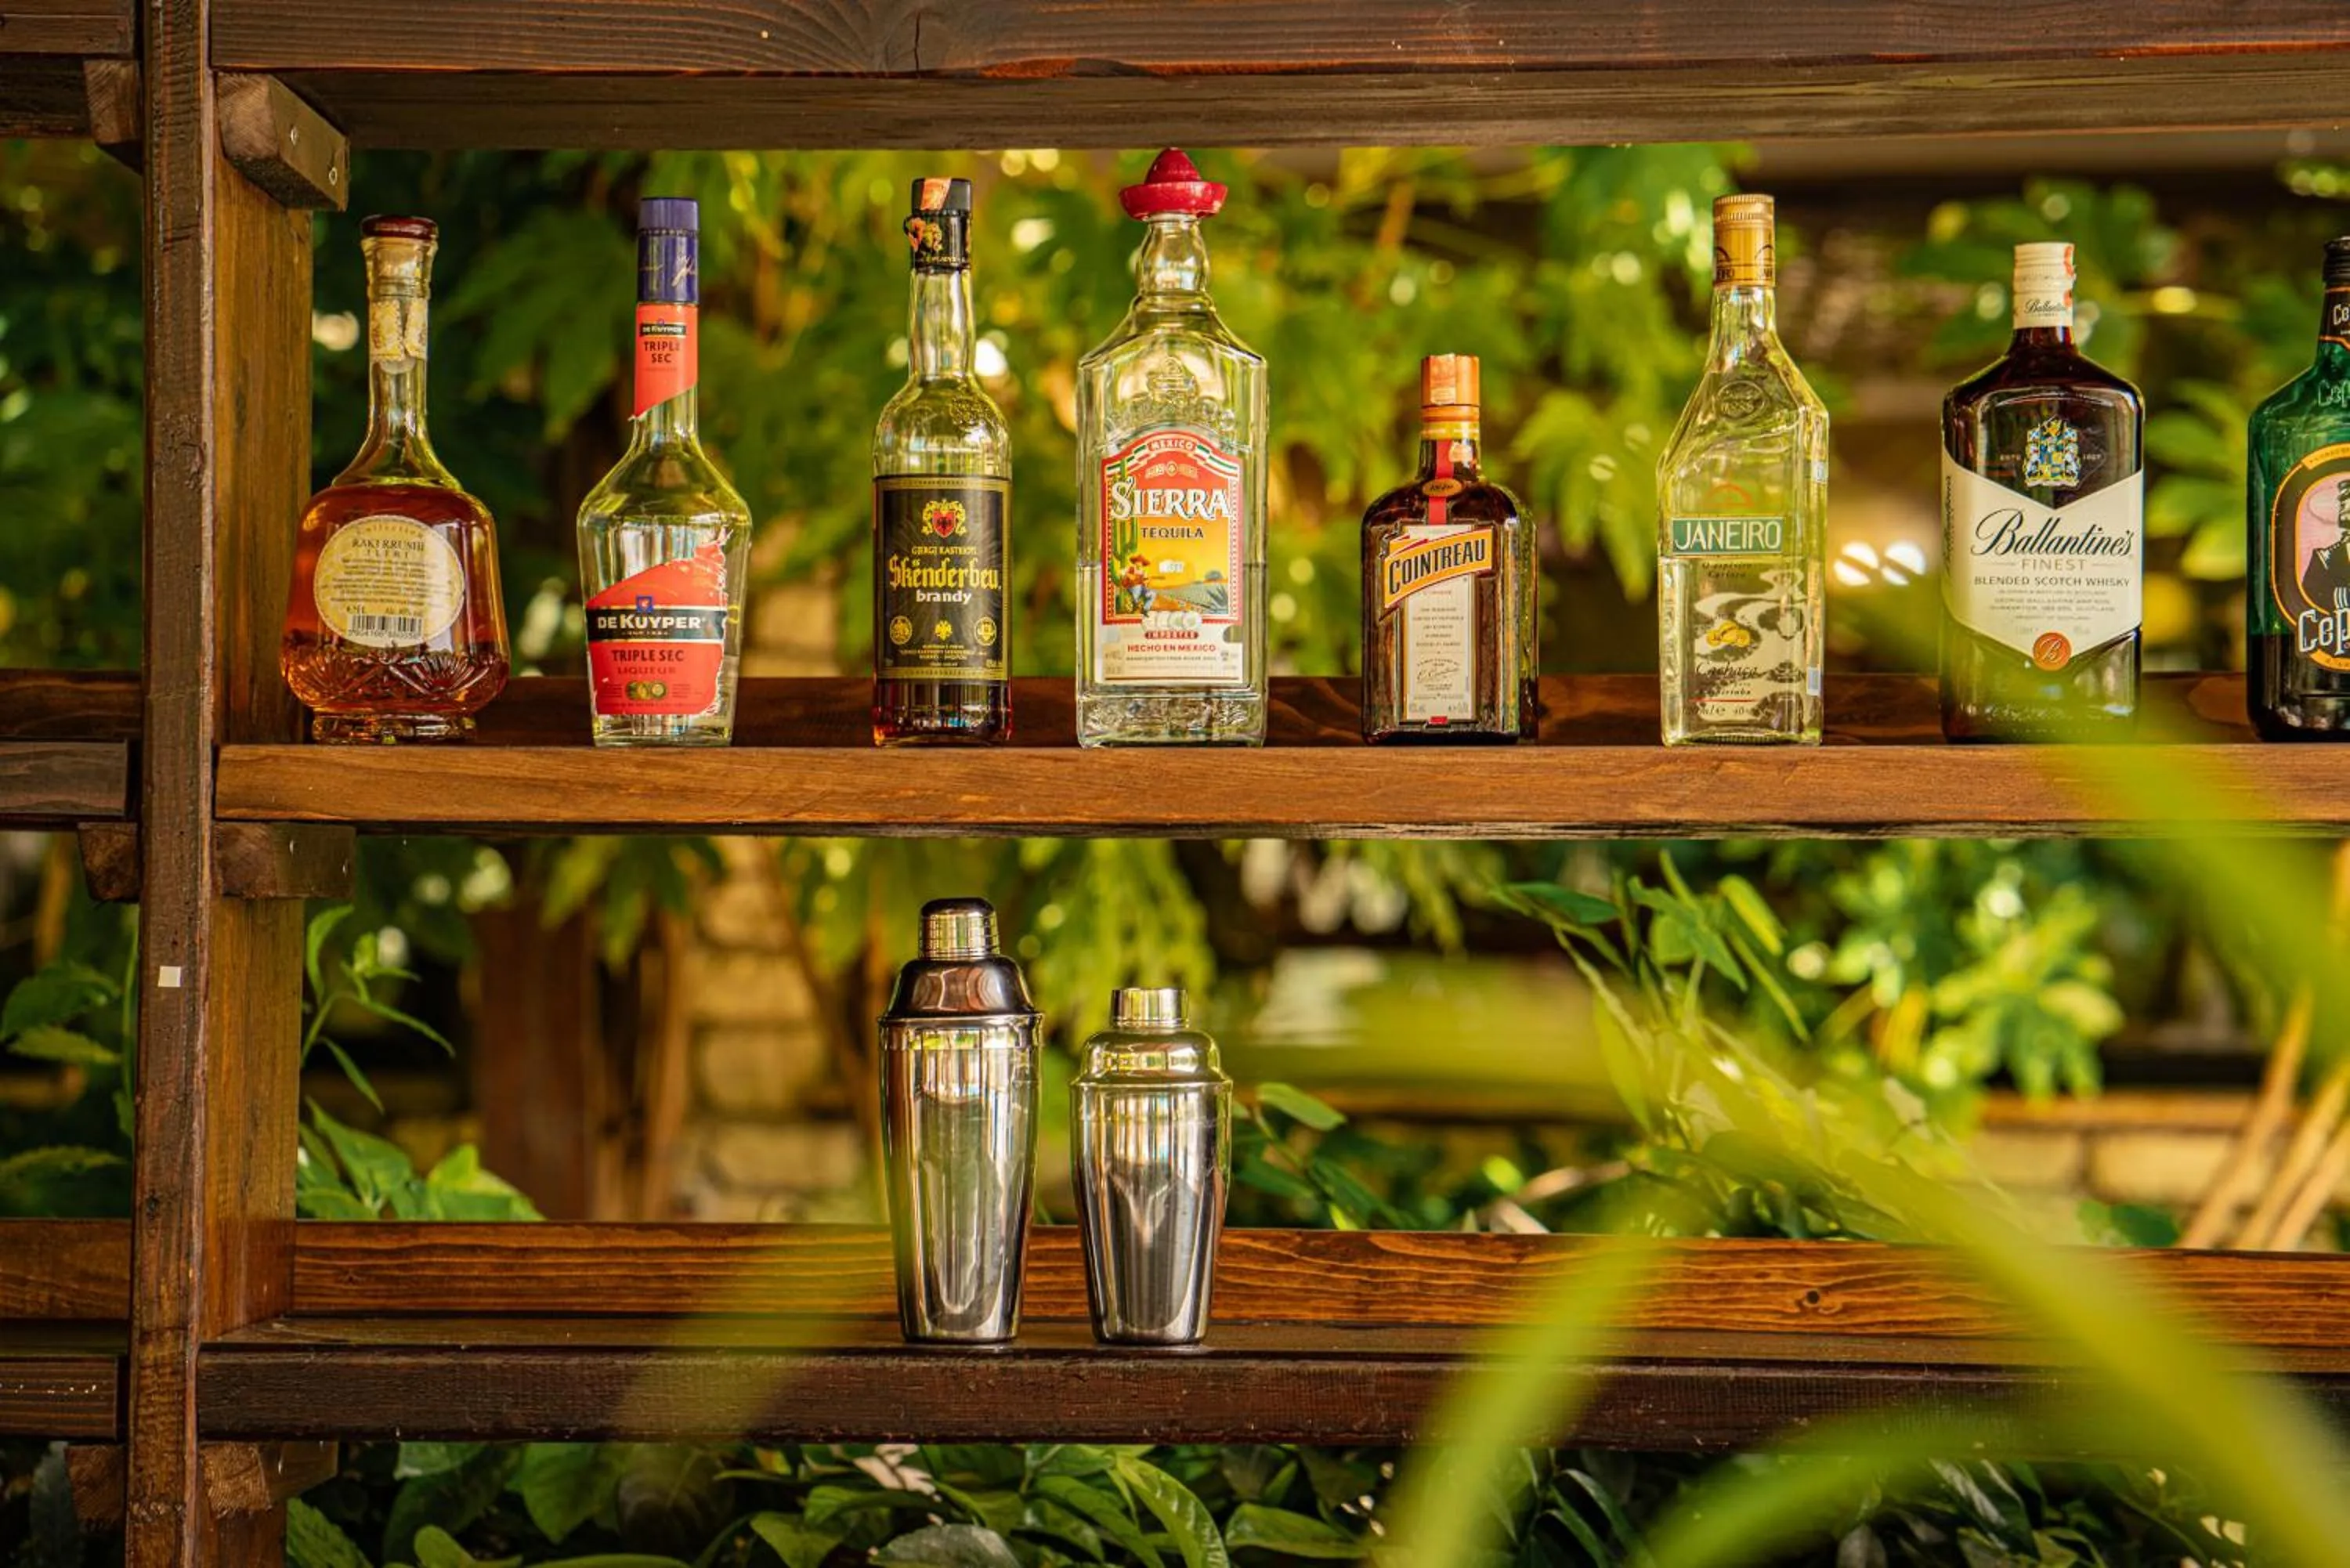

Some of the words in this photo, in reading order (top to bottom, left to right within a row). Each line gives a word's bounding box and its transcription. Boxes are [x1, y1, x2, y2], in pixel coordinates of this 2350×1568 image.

[644, 341, 680, 352] TRIPLE
[651, 353, 671, 363] SEC
[1111, 475, 1231, 520] SIERRA
[1141, 527, 1204, 538] TEQUILA
[1675, 520, 1781, 550] JANEIRO
[1970, 508, 2135, 557] Ballantine's
[1388, 537, 1487, 596] COINTREAU
[2021, 558, 2087, 571] FINEST
[1973, 576, 2030, 586] BLENDED
[2034, 576, 2082, 586] SCOTCH
[2085, 576, 2131, 587] WHISKY
[916, 590, 972, 605] brandy
[1127, 644, 1162, 653] HECHO
[1163, 644, 1177, 652] EN
[611, 649, 656, 663] TRIPLE
[659, 649, 685, 662] SEC
